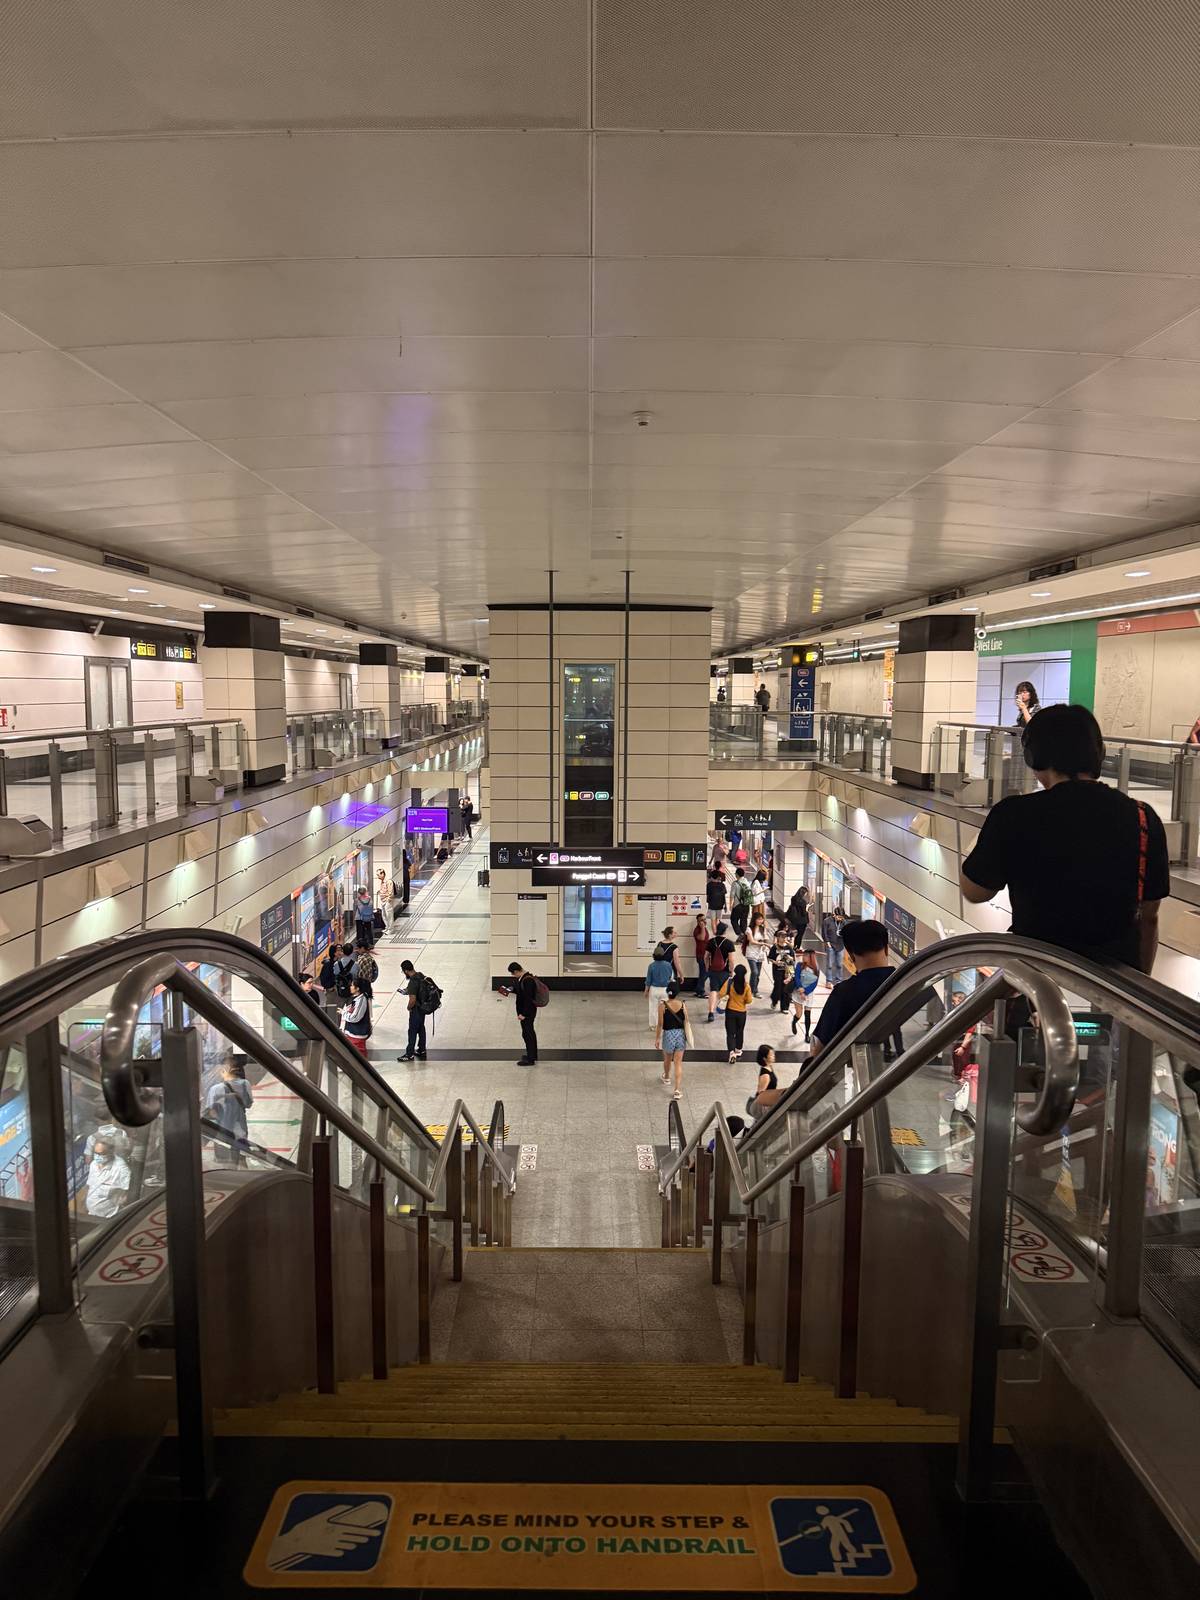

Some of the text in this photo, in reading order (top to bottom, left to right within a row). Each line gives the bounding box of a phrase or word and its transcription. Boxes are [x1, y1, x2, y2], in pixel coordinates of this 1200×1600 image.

[991, 638, 1003, 650] Line
[412, 1513, 750, 1529] PLEASE MIND YOUR STEP &
[406, 1535, 755, 1555] HOLD ONTO HANDRAIL
